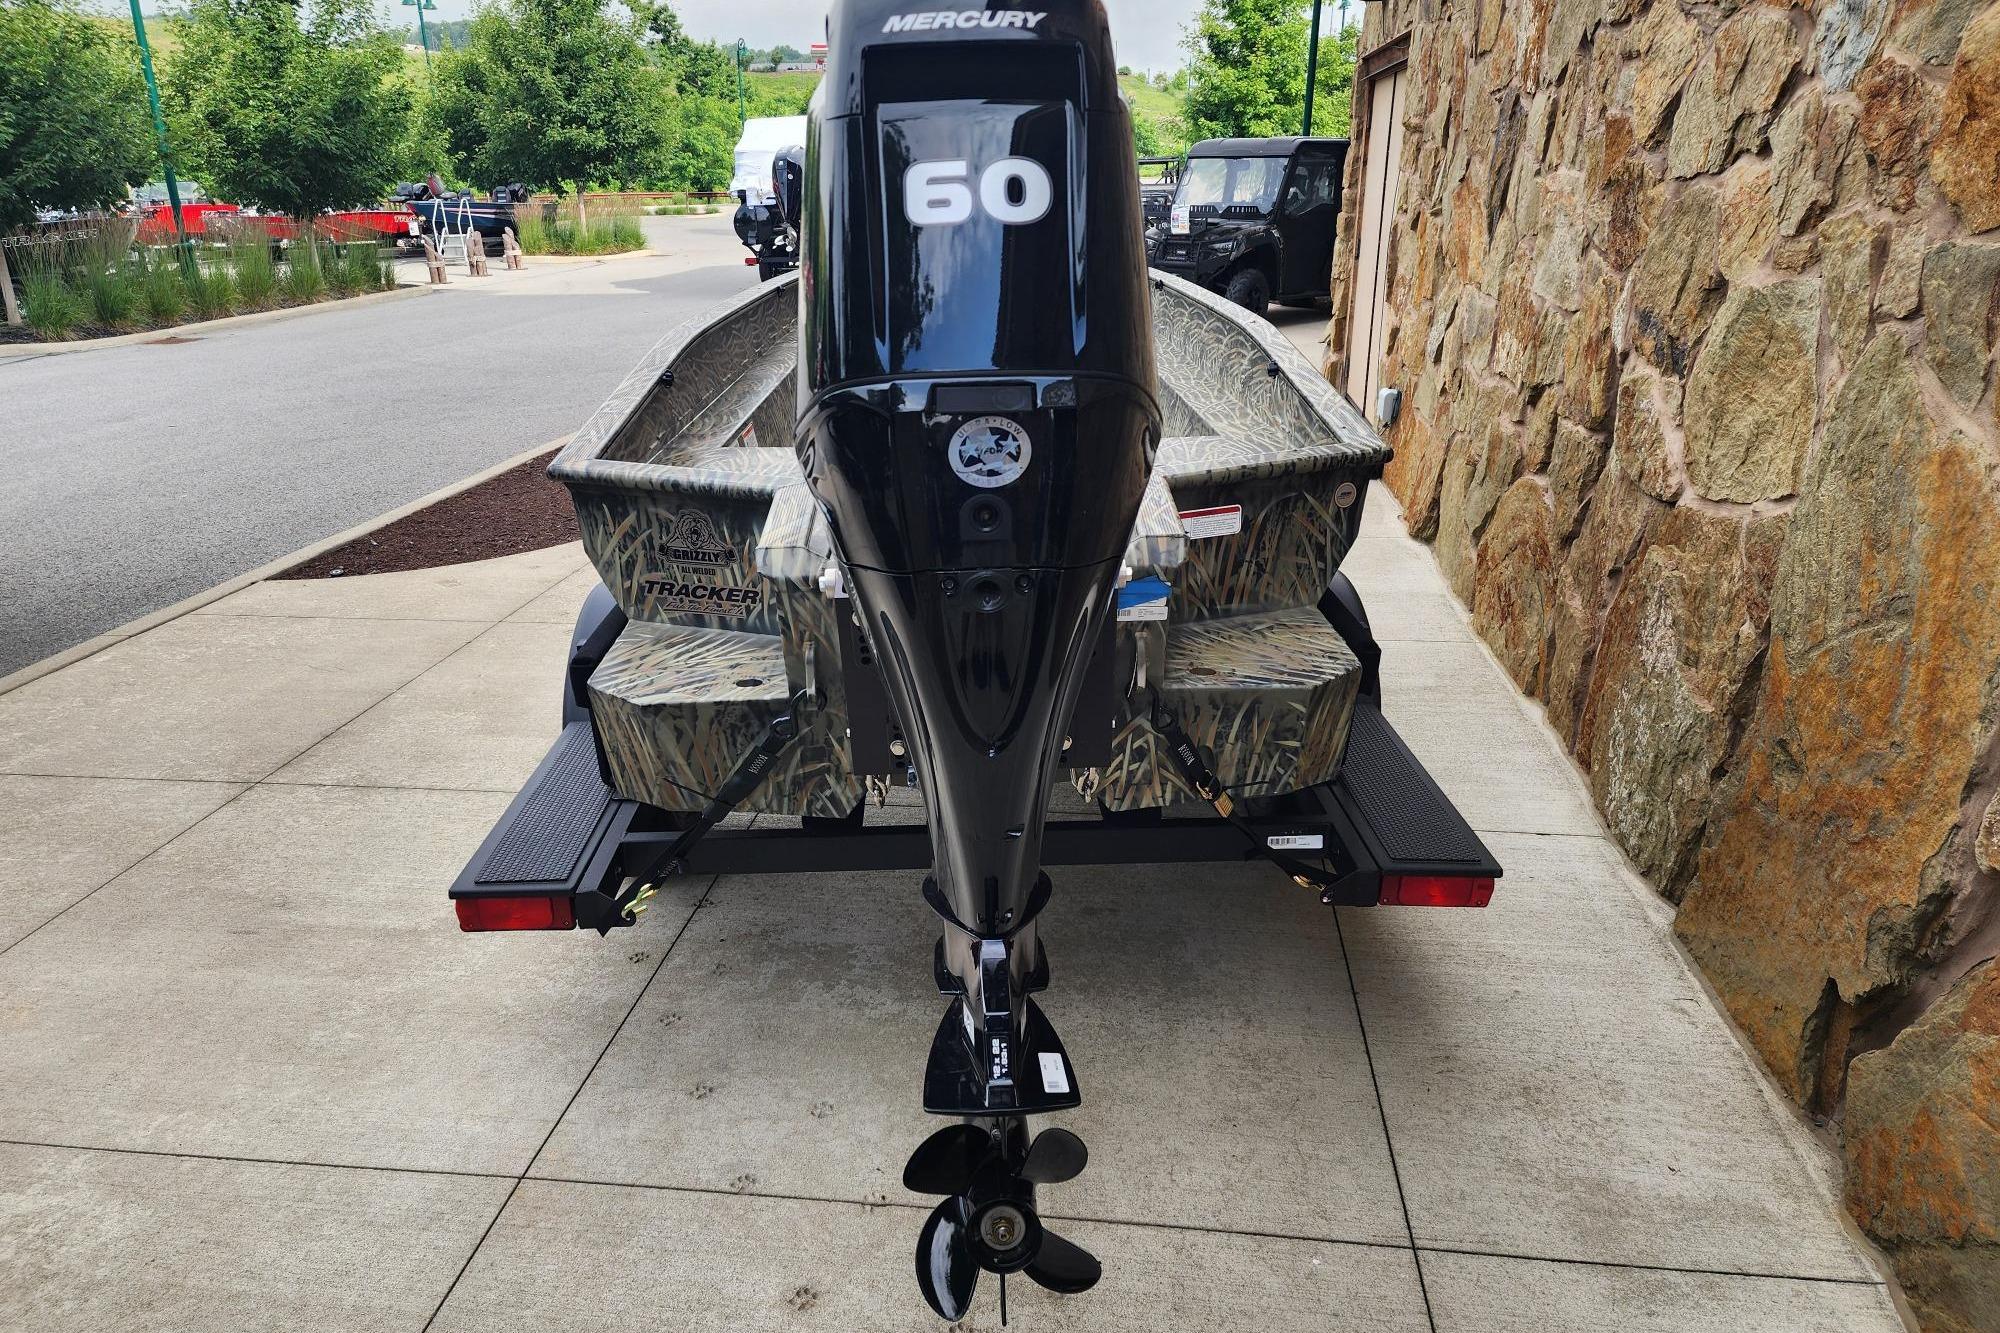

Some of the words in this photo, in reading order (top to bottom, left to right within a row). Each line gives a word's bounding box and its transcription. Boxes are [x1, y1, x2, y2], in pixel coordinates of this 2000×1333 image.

[882, 10, 1048, 34] MERCURY
[903, 155, 1055, 227] 60
[999, 418, 1023, 436] LOW
[672, 549, 720, 562] GRIZZLY
[681, 566, 692, 574] ALL
[692, 567, 716, 576] WELDED
[644, 580, 760, 605] TRACKER
[991, 1038, 1000, 1055] 22
[992, 1065, 1001, 1079] 12
